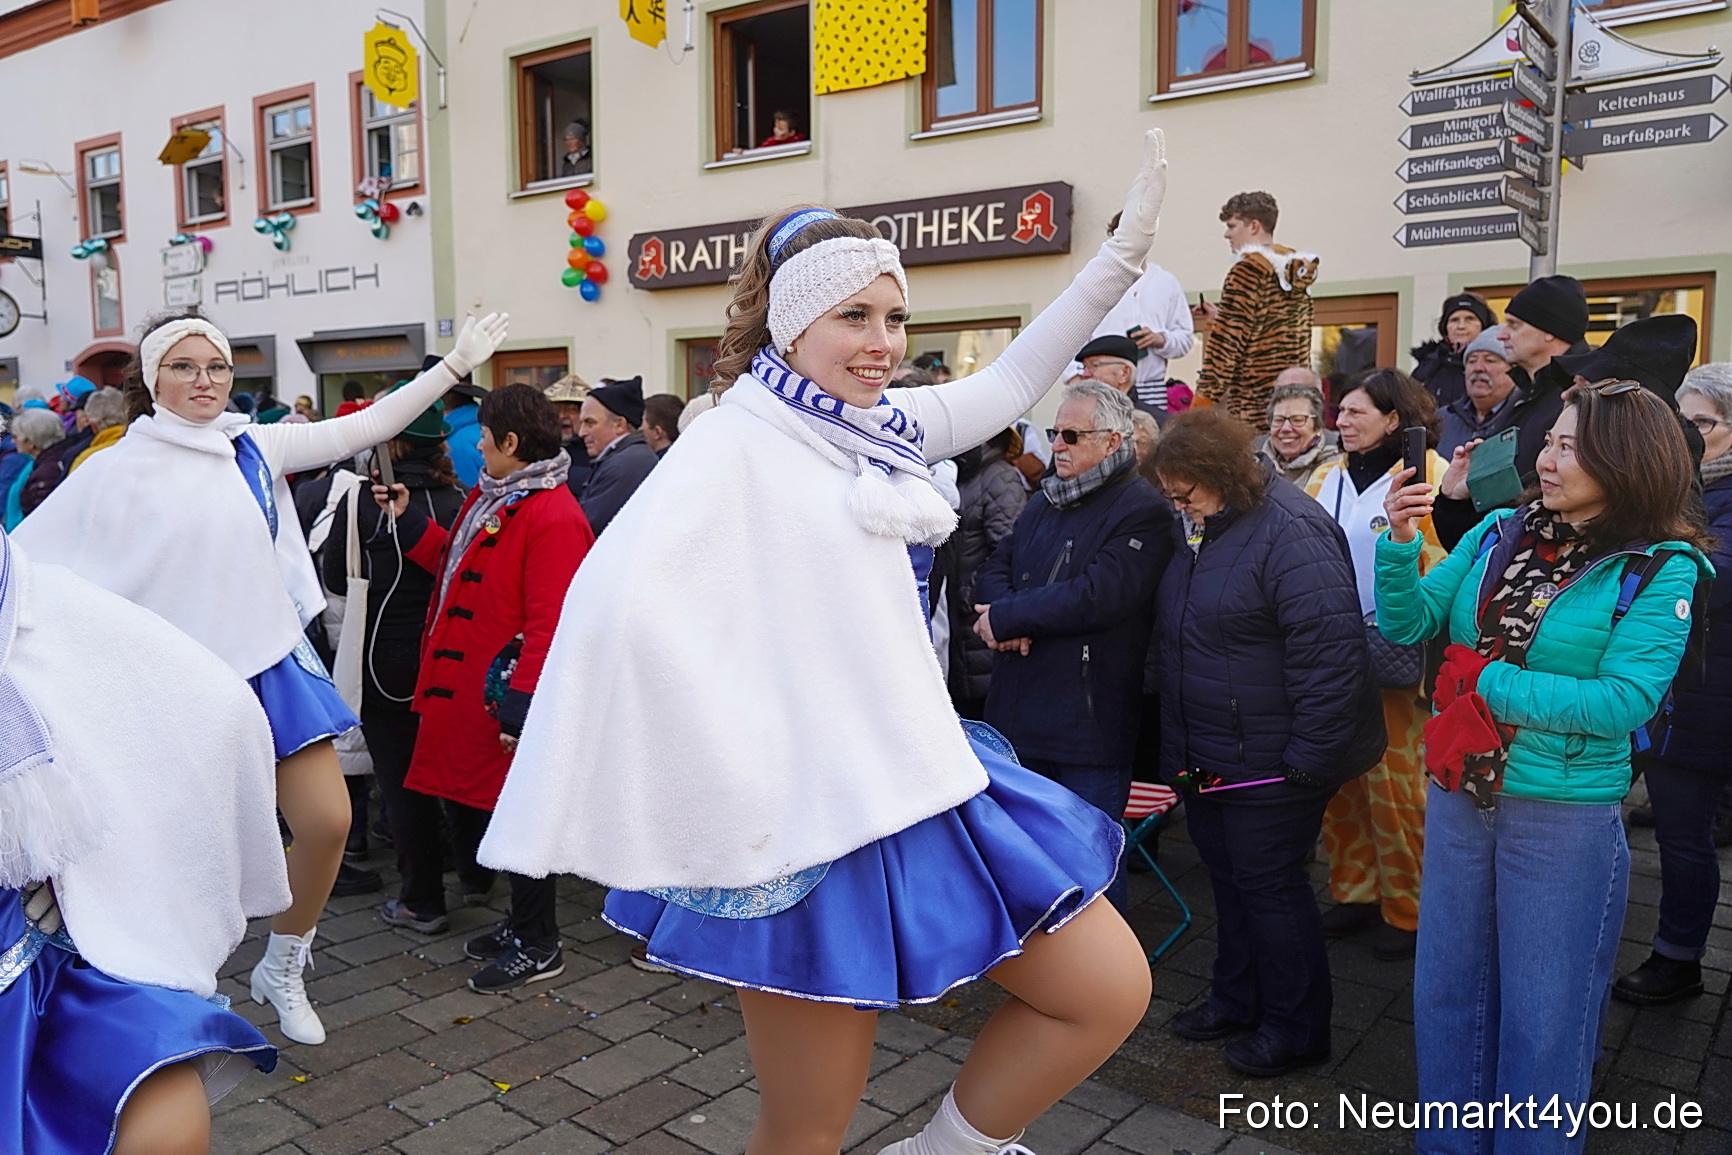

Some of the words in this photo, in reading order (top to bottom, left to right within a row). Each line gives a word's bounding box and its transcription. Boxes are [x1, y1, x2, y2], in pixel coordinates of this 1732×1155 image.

[1453, 96, 1482, 110] 3km
[1598, 89, 1686, 112] Keltenhaus
[1443, 114, 1498, 132] Minigolf
[1602, 123, 1692, 146] Barfußpark
[1421, 129, 1485, 147] Mühlbach
[1408, 185, 1499, 208] Schönblickfel
[669, 232, 750, 274] RATH
[870, 201, 1006, 250] OTHEKE
[1410, 222, 1517, 241] Mühlenmuseum
[214, 263, 380, 304] RÖHLICH
